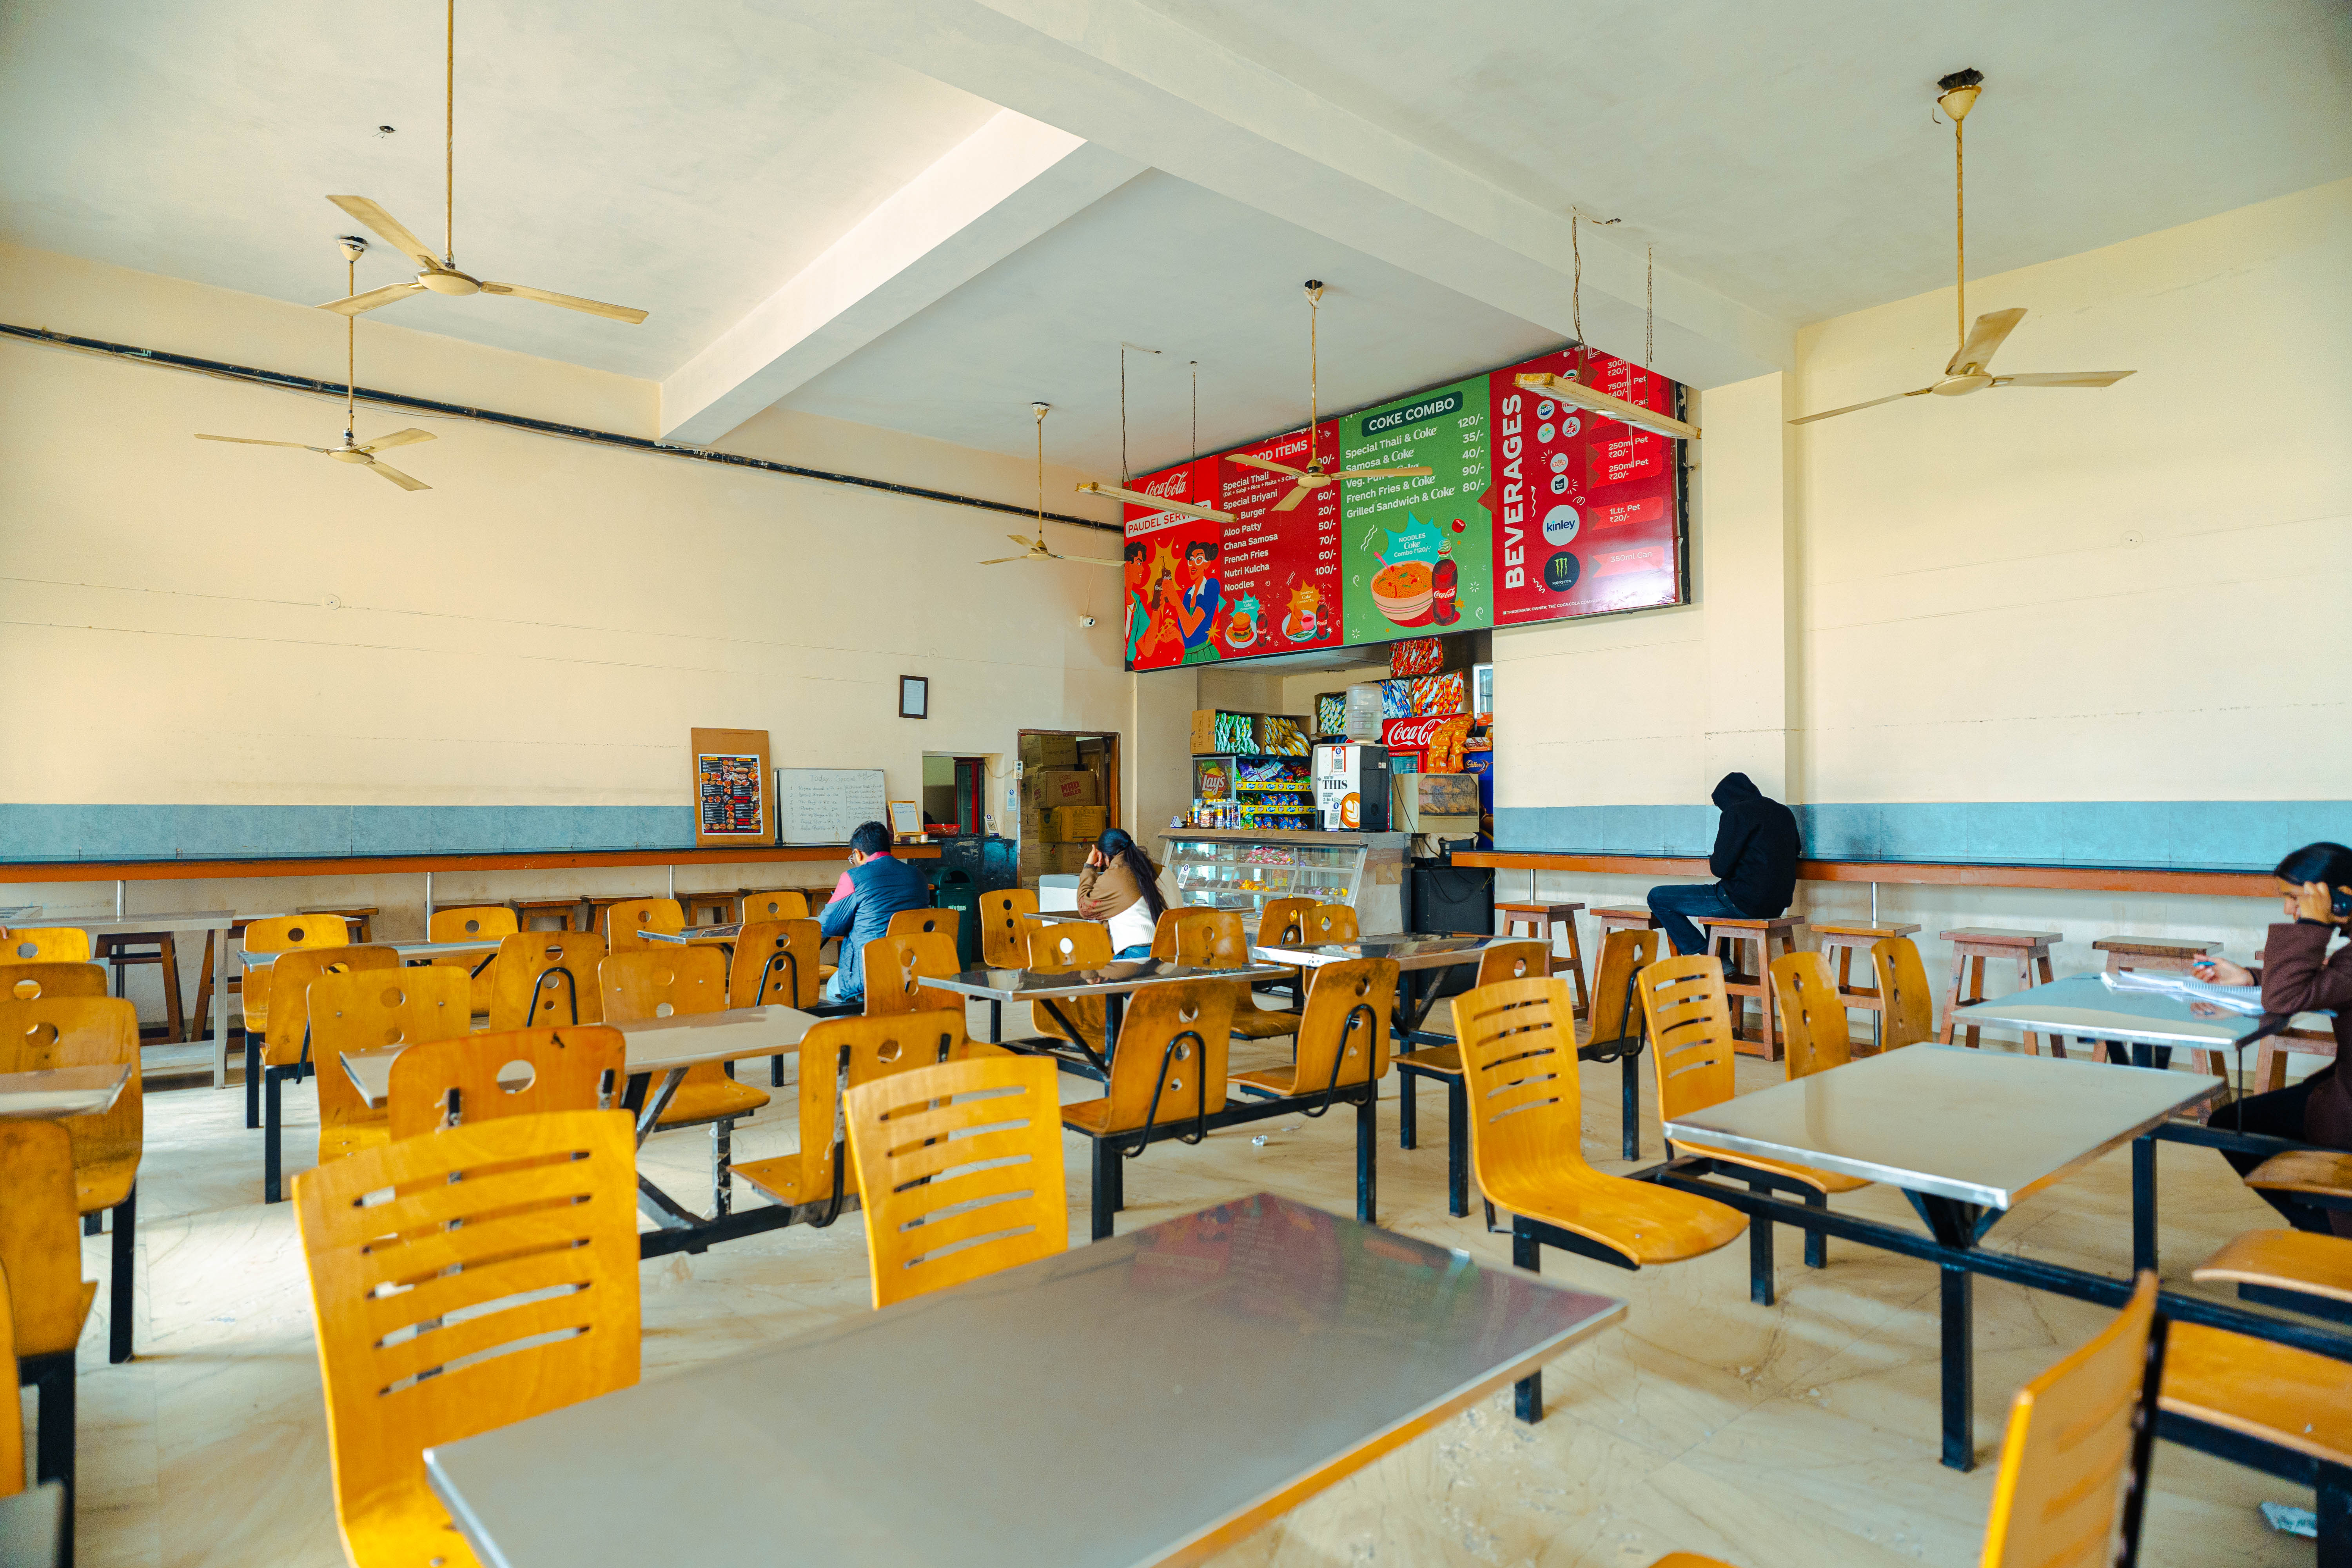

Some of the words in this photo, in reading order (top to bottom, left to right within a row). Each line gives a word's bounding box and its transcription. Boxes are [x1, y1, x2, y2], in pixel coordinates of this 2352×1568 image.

[1633, 376, 1646, 385] Pet
[1369, 412, 1402, 431] COKE
[1405, 398, 1454, 420] COMBO
[1345, 442, 1378, 459] Special
[1380, 435, 1402, 449] Thali
[1405, 434, 1411, 443] &
[1413, 426, 1437, 440] Coke
[1458, 413, 1484, 428] 120/-
[1608, 439, 1633, 450] 250ml
[1276, 440, 1308, 458] ITEMS
[1346, 458, 1381, 471] Samosa
[1383, 455, 1390, 463] &
[1391, 448, 1415, 461] Coke
[1463, 430, 1484, 443] 35/-
[1462, 446, 1484, 459] 40/-
[1609, 448, 1628, 458] ₹20/-
[1609, 461, 1633, 472] 250ml
[1635, 459, 1648, 467] Pet
[1223, 476, 1249, 490] Special
[1251, 472, 1269, 483] Thali
[1346, 477, 1365, 488] Veg.
[1347, 490, 1376, 503] French
[1378, 485, 1401, 495] Fries
[1403, 481, 1410, 490] &
[1412, 475, 1436, 488] Coke
[1462, 463, 1484, 476] 90/-
[1609, 470, 1629, 480] ₹20/-
[1145, 471, 1189, 498] Coca-Cola
[1502, 394, 1524, 589] BEVERAGES
[1223, 495, 1250, 510] Special
[1252, 489, 1278, 503] Briyani
[1241, 508, 1266, 519] Burger
[1318, 490, 1335, 501] 60/-
[1347, 504, 1374, 518] Grilled
[1376, 495, 1419, 512] Sandwich
[1422, 493, 1428, 501] &
[1431, 486, 1455, 499] Coke
[1463, 479, 1485, 492] 80/-
[1128, 517, 1161, 534] PAUDEL
[1224, 528, 1240, 537] Aloo
[1242, 523, 1262, 533] Patty
[1318, 505, 1336, 516] 20/-
[1547, 520, 1575, 532] kinley
[1610, 514, 1630, 523] ₹20/-
[1224, 540, 1247, 550] Chana
[1248, 534, 1278, 546] Samosa
[1318, 519, 1336, 530] 50/-
[1399, 533, 1426, 543] NOODLES
[1224, 553, 1248, 564] French
[1250, 550, 1269, 559] Fries
[1319, 534, 1336, 545] 70/-
[1404, 541, 1421, 550] Coke
[1224, 568, 1242, 578] Nutri
[1244, 564, 1270, 574] Kulcha
[1319, 549, 1336, 560] 60/-
[1611, 554, 1635, 563] 350ml
[1225, 581, 1254, 592] Noodles
[1315, 564, 1337, 575] 100/-
[1434, 587, 1455, 599] Coca-Cola
[1388, 718, 1450, 747] Coca-C
[1061, 781, 1080, 793] MAD
[1063, 789, 1081, 798] ANGLES
[1202, 775, 1225, 795] Lay's
[1323, 780, 1347, 789] THIS
